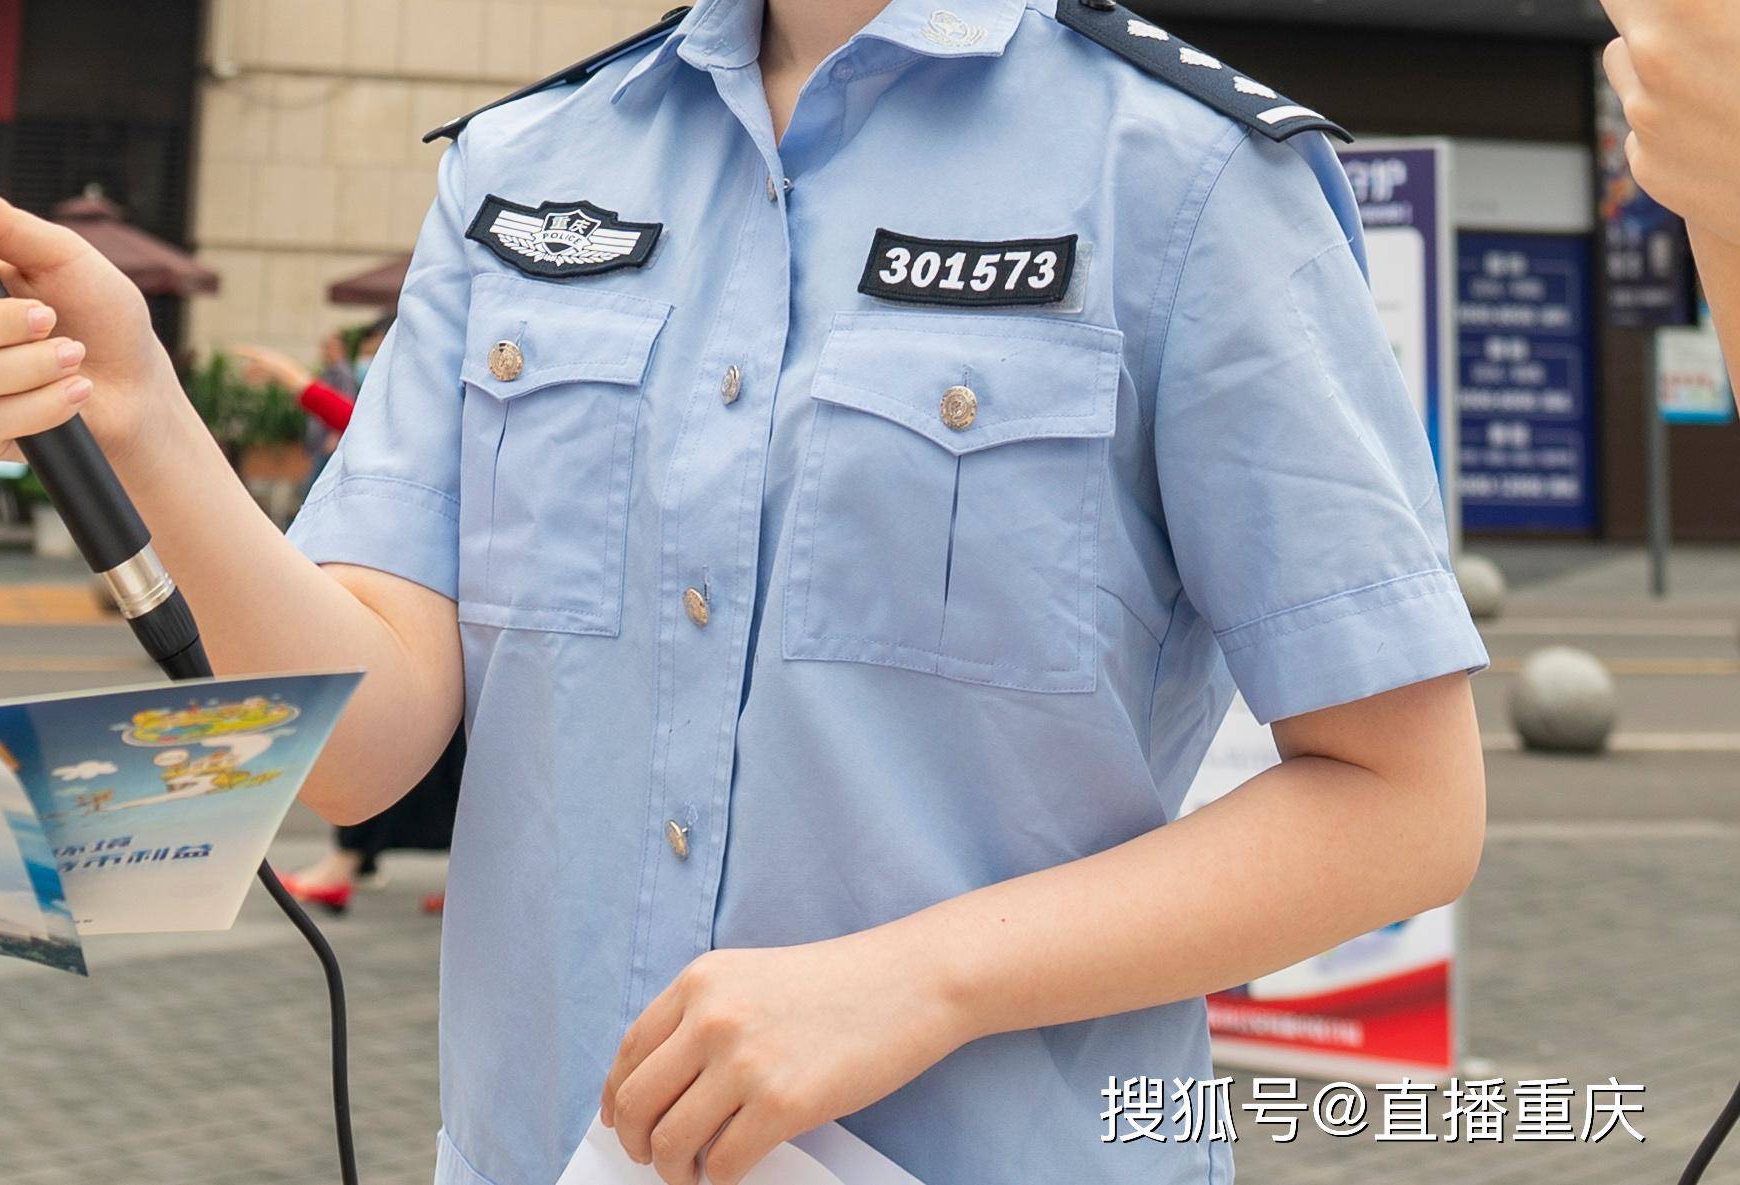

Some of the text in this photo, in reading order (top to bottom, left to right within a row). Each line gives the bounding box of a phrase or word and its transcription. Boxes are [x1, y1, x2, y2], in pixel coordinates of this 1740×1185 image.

[550, 214, 589, 235] 重庆
[543, 231, 583, 245] POLICE
[879, 247, 1057, 293] 301573
